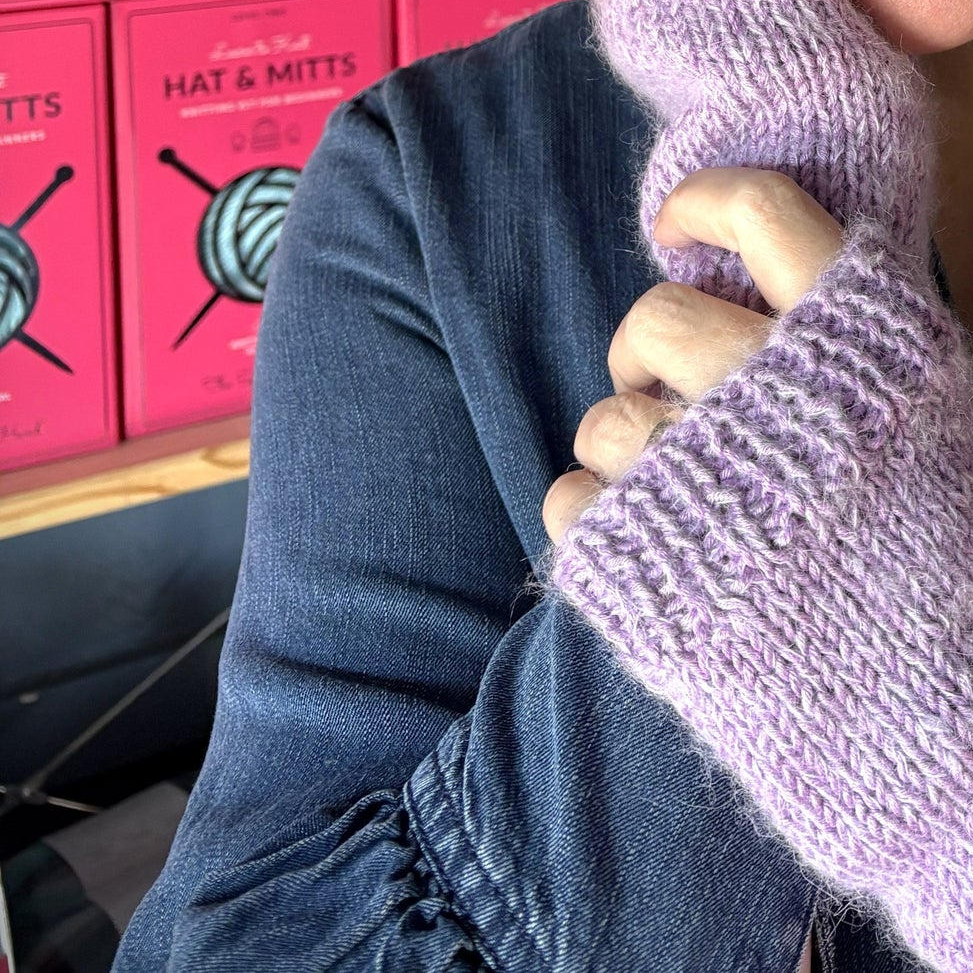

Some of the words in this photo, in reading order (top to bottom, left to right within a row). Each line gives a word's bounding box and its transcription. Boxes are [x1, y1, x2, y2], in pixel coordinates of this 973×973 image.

[163, 68, 227, 99] HAT
[235, 64, 255, 90] &
[266, 52, 358, 87] MITTS
